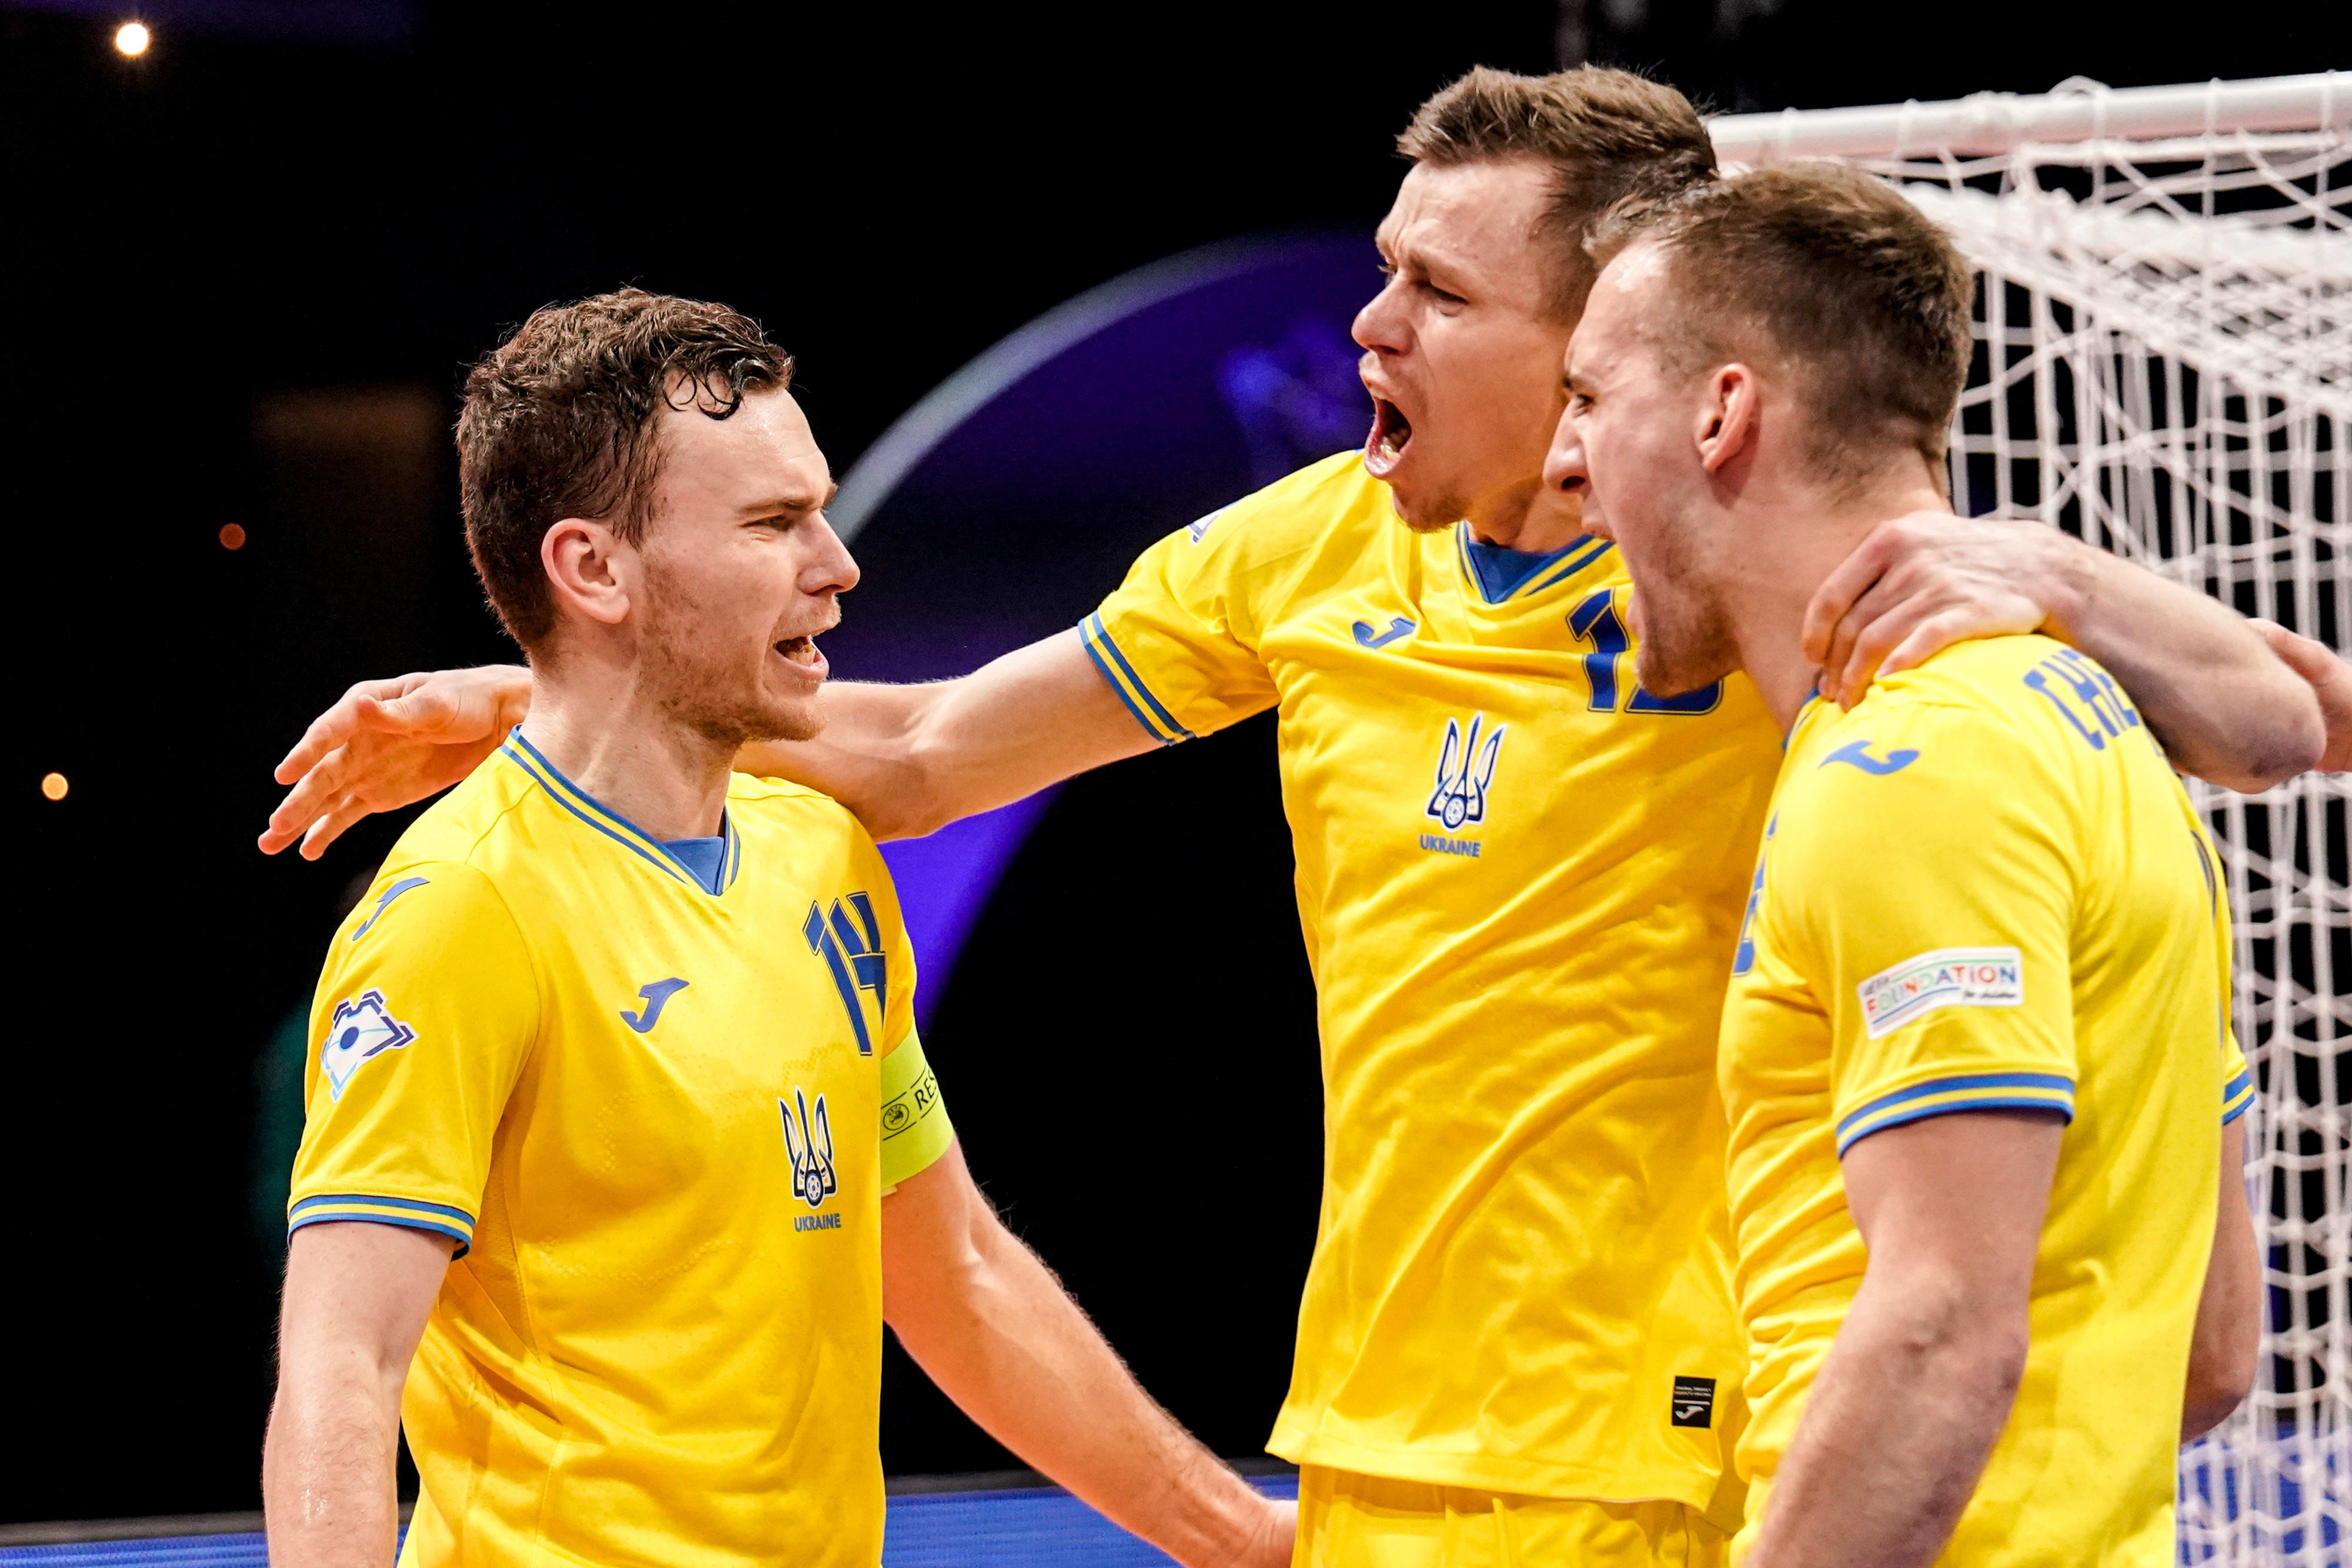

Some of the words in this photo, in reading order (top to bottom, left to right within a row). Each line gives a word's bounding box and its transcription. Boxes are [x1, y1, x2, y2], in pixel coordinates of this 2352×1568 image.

[1566, 586, 1725, 716] 1
[2022, 648, 2165, 757] CHE
[1419, 834, 1481, 858] UKRAINE
[802, 890, 887, 1057] 14
[1866, 965, 2016, 1012] FOUNDATION
[794, 1212, 841, 1232] UKRAINE
